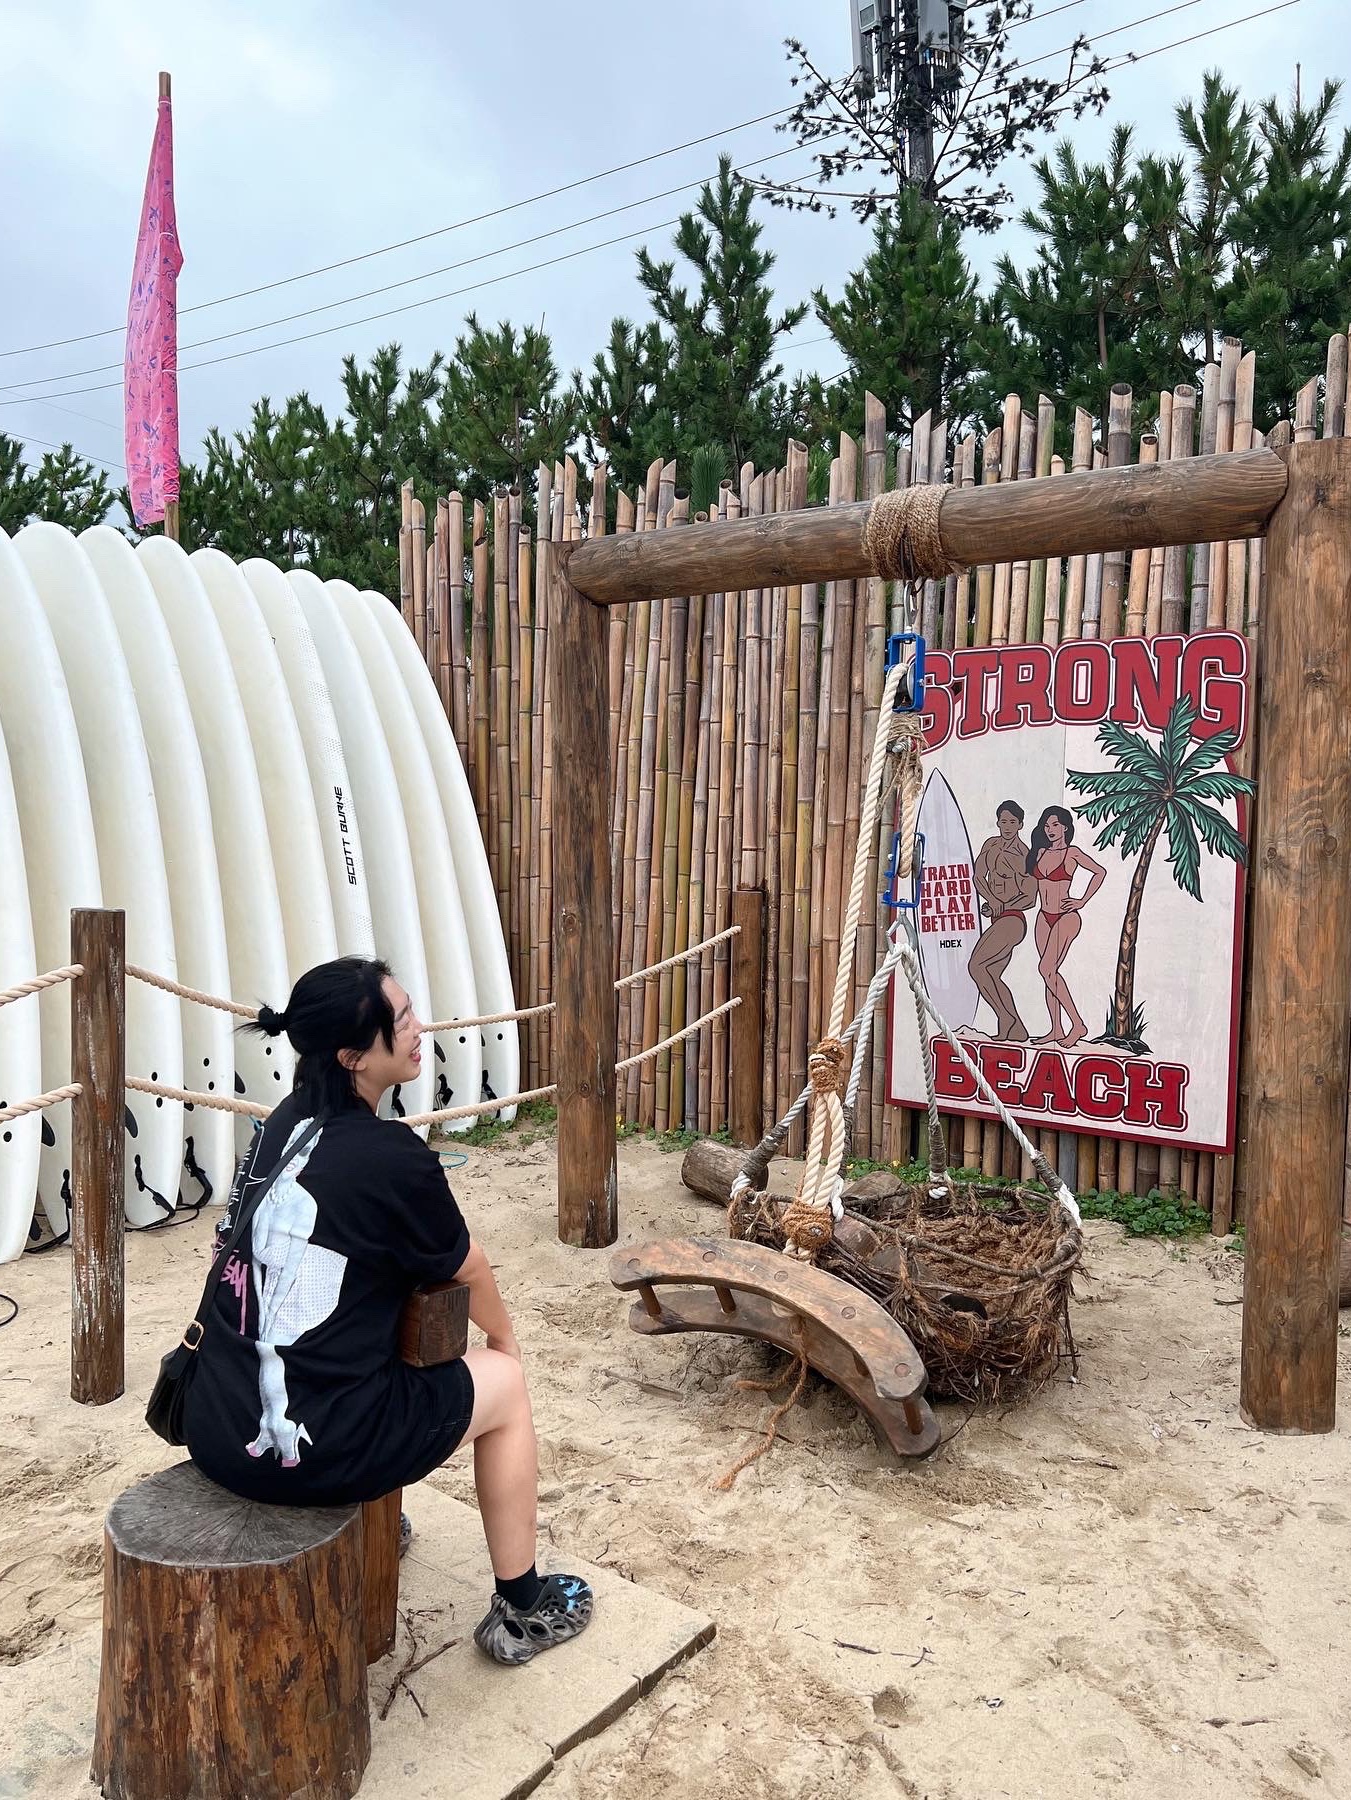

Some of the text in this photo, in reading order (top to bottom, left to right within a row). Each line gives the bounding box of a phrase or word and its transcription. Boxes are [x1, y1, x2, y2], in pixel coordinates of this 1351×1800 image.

[908, 631, 1248, 754] STRONG
[334, 786, 357, 886] SCOTT BURKE
[921, 863, 970, 882] TRAIN
[921, 879, 972, 898] HARD
[921, 895, 972, 915] PLAY
[921, 913, 976, 933] BETTER
[939, 939, 963, 949] HDEX
[930, 1037, 1190, 1132] BEACH
